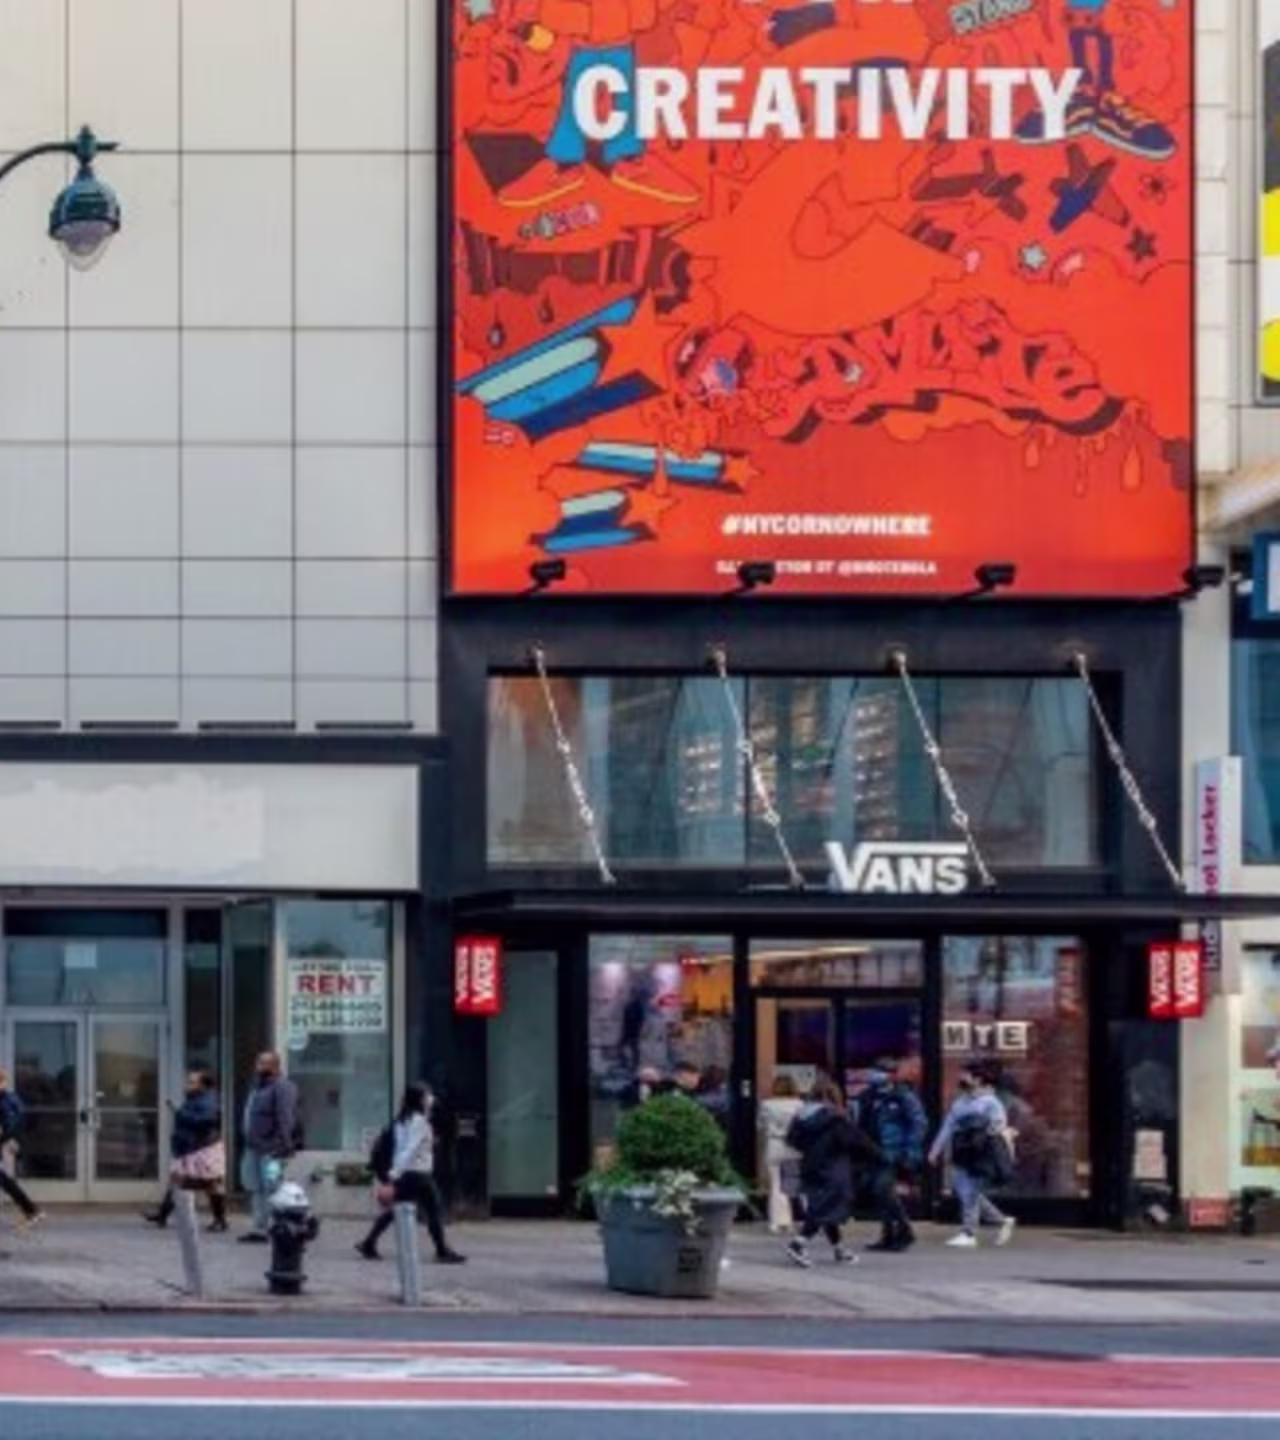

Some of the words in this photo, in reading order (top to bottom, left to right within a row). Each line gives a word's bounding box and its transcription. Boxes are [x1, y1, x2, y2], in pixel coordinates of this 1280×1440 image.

[572, 64, 1083, 141] CREATIVITY
[721, 513, 932, 536] #NYCORNOWHERE
[827, 841, 969, 896] VANS
[297, 974, 377, 995] RENT
